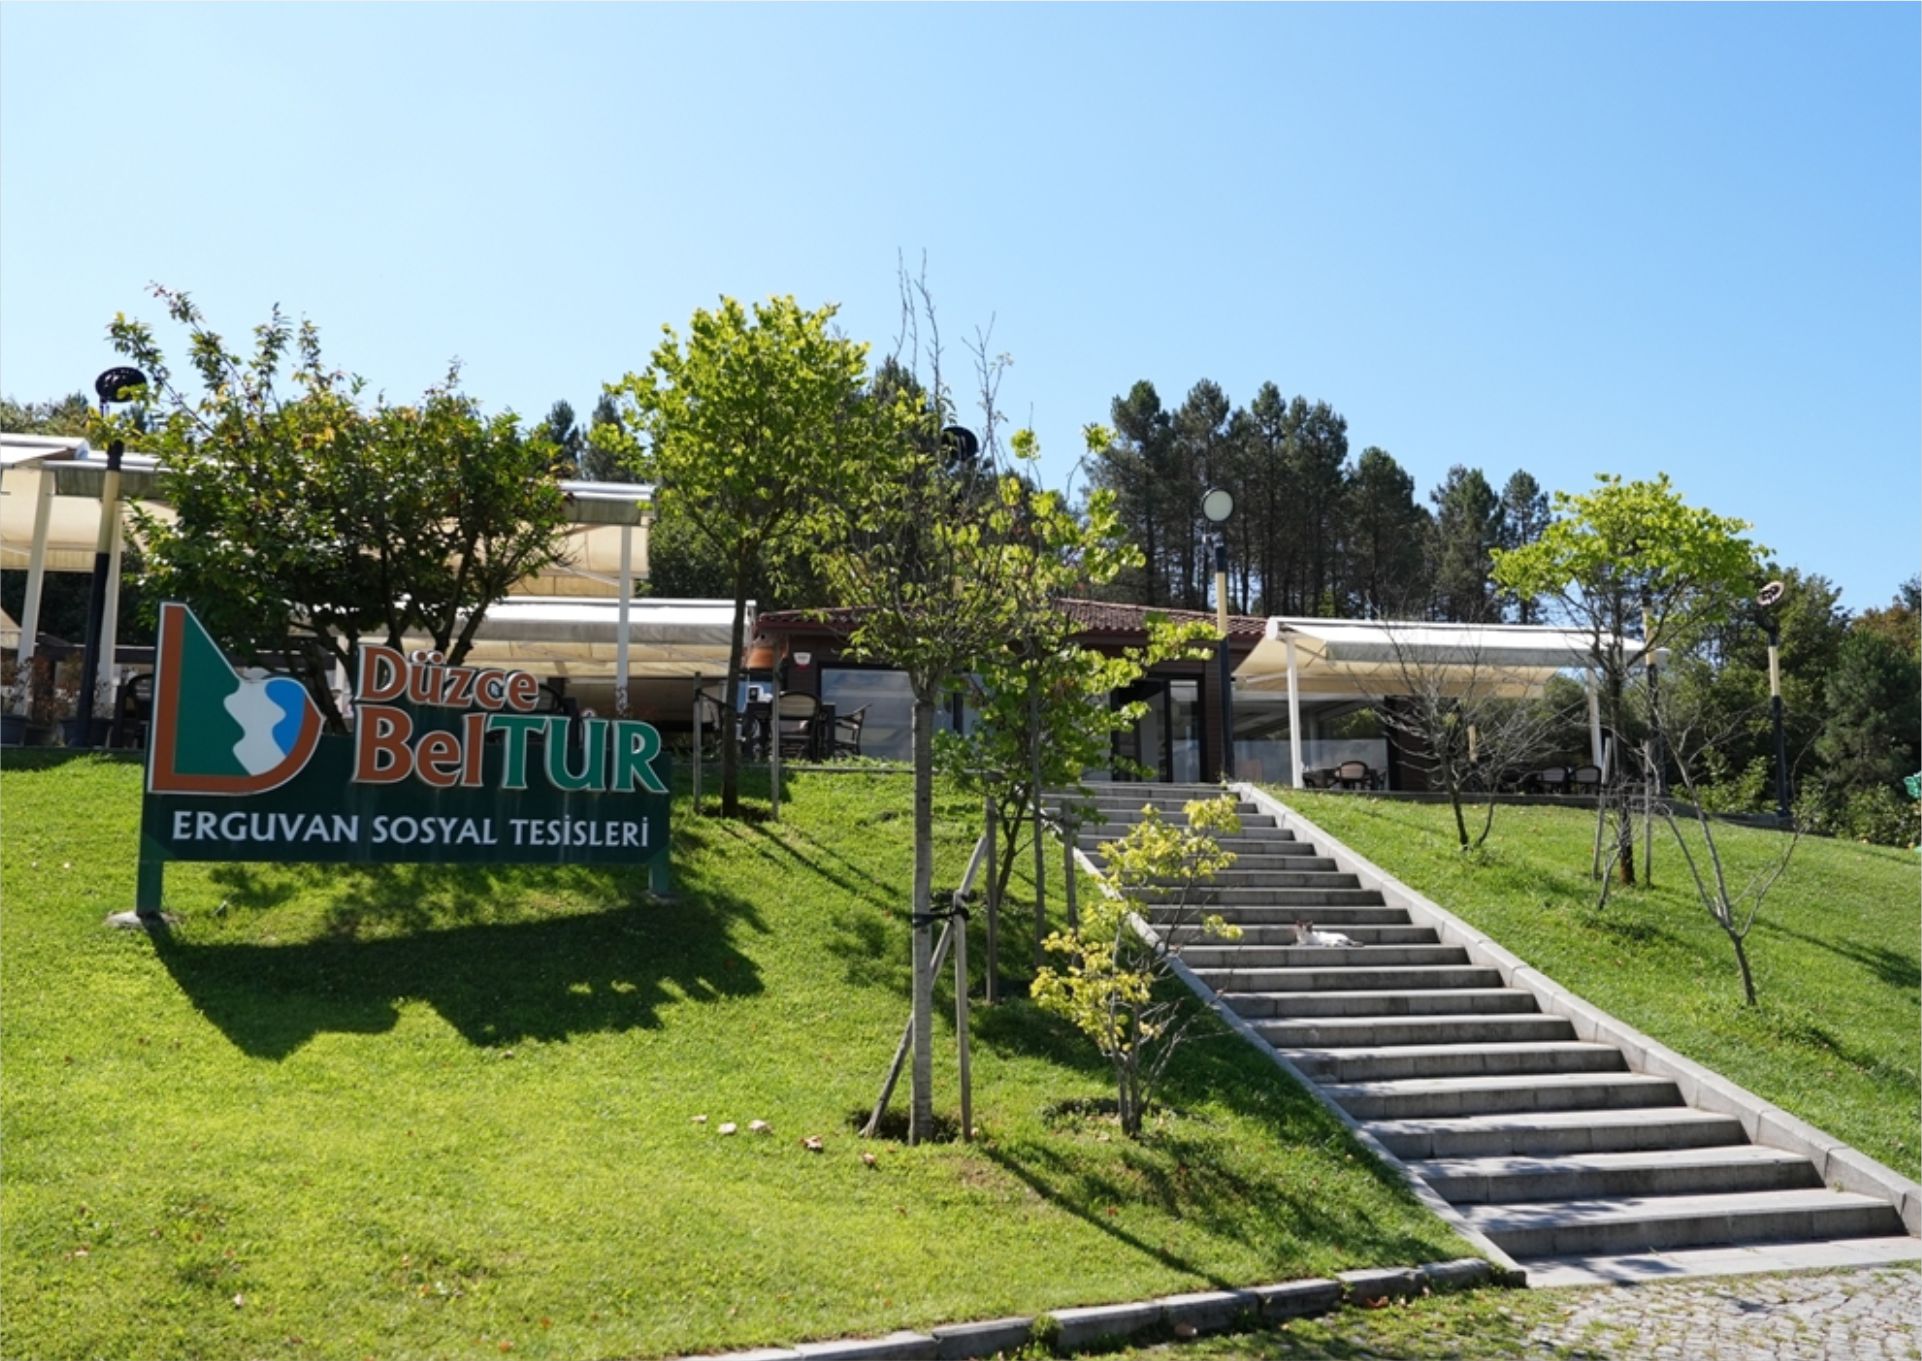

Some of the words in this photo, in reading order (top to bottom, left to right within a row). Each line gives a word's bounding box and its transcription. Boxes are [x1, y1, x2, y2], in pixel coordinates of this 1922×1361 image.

[355, 644, 539, 710] Düzce
[354, 705, 667, 792] BelTUR
[172, 810, 358, 843] ERGUVAN
[372, 816, 498, 846] SOSYAL
[511, 814, 649, 847] TESİSLERİ
